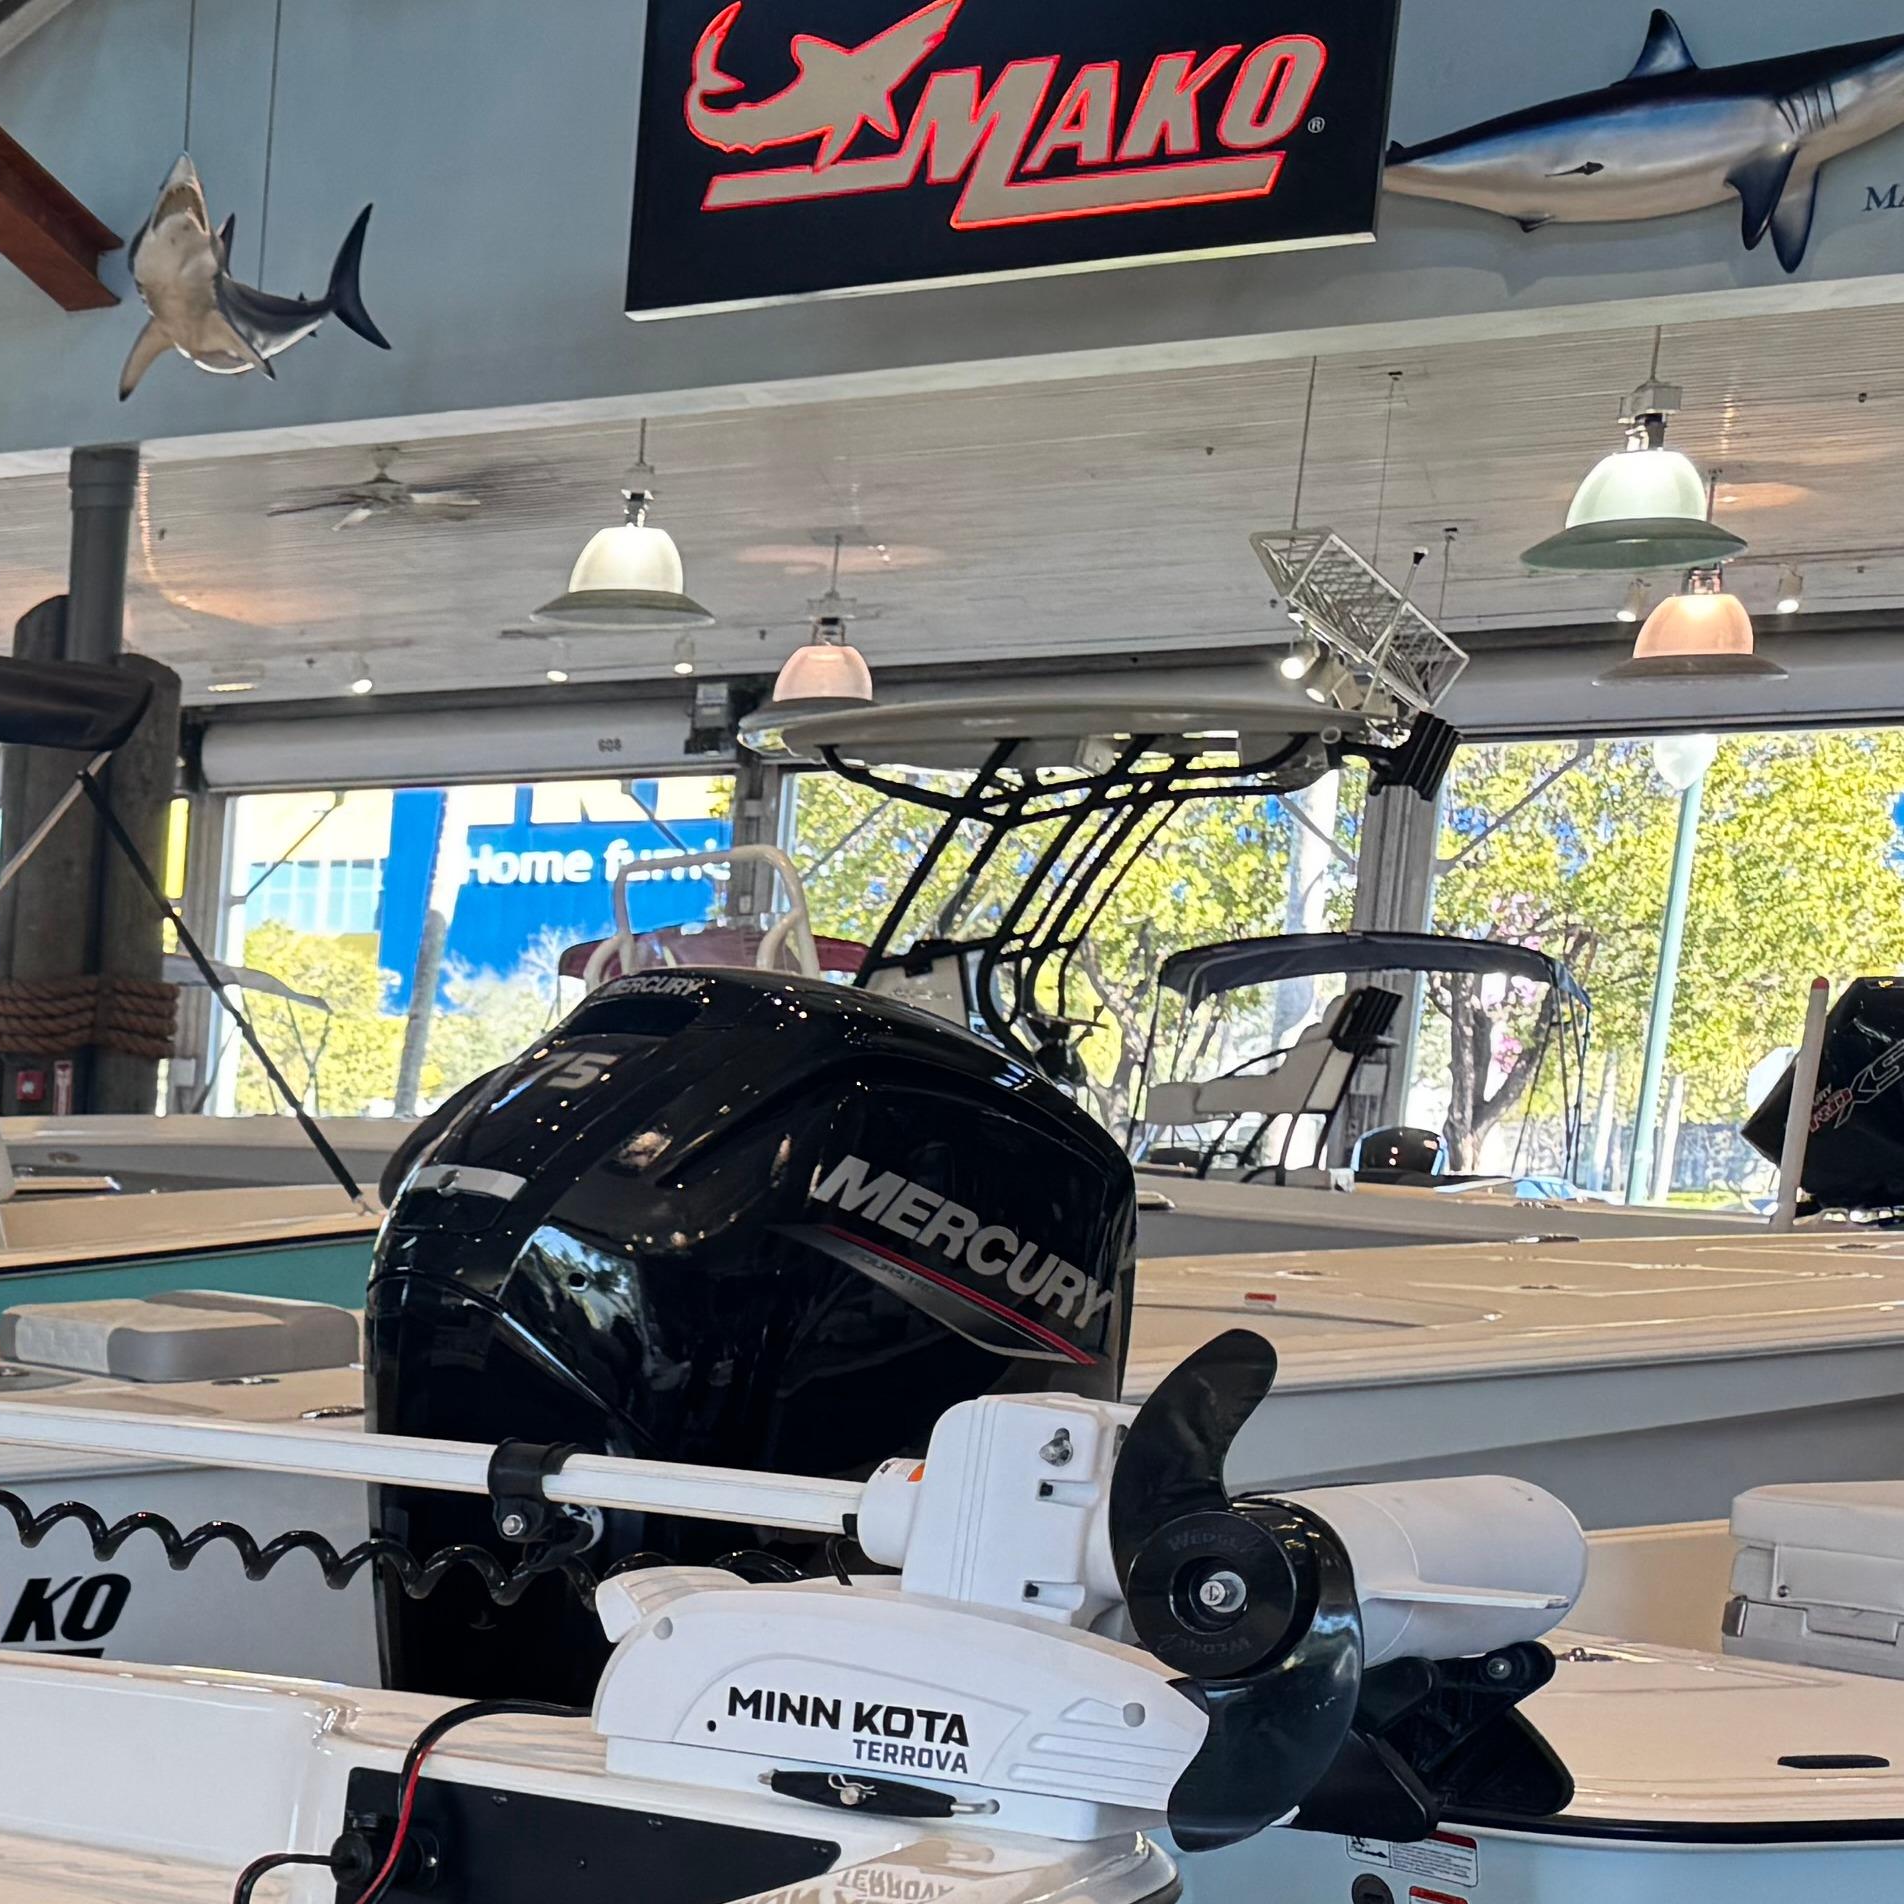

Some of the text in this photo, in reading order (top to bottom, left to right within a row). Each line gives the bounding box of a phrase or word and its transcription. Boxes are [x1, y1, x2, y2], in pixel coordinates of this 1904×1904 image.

[700, 33, 1329, 231] MAKO
[465, 843, 593, 885] Home
[811, 1154, 1115, 1330] MERCURY
[727, 1686, 970, 1748] MINN KOTA
[852, 1737, 969, 1775] TERROVA
